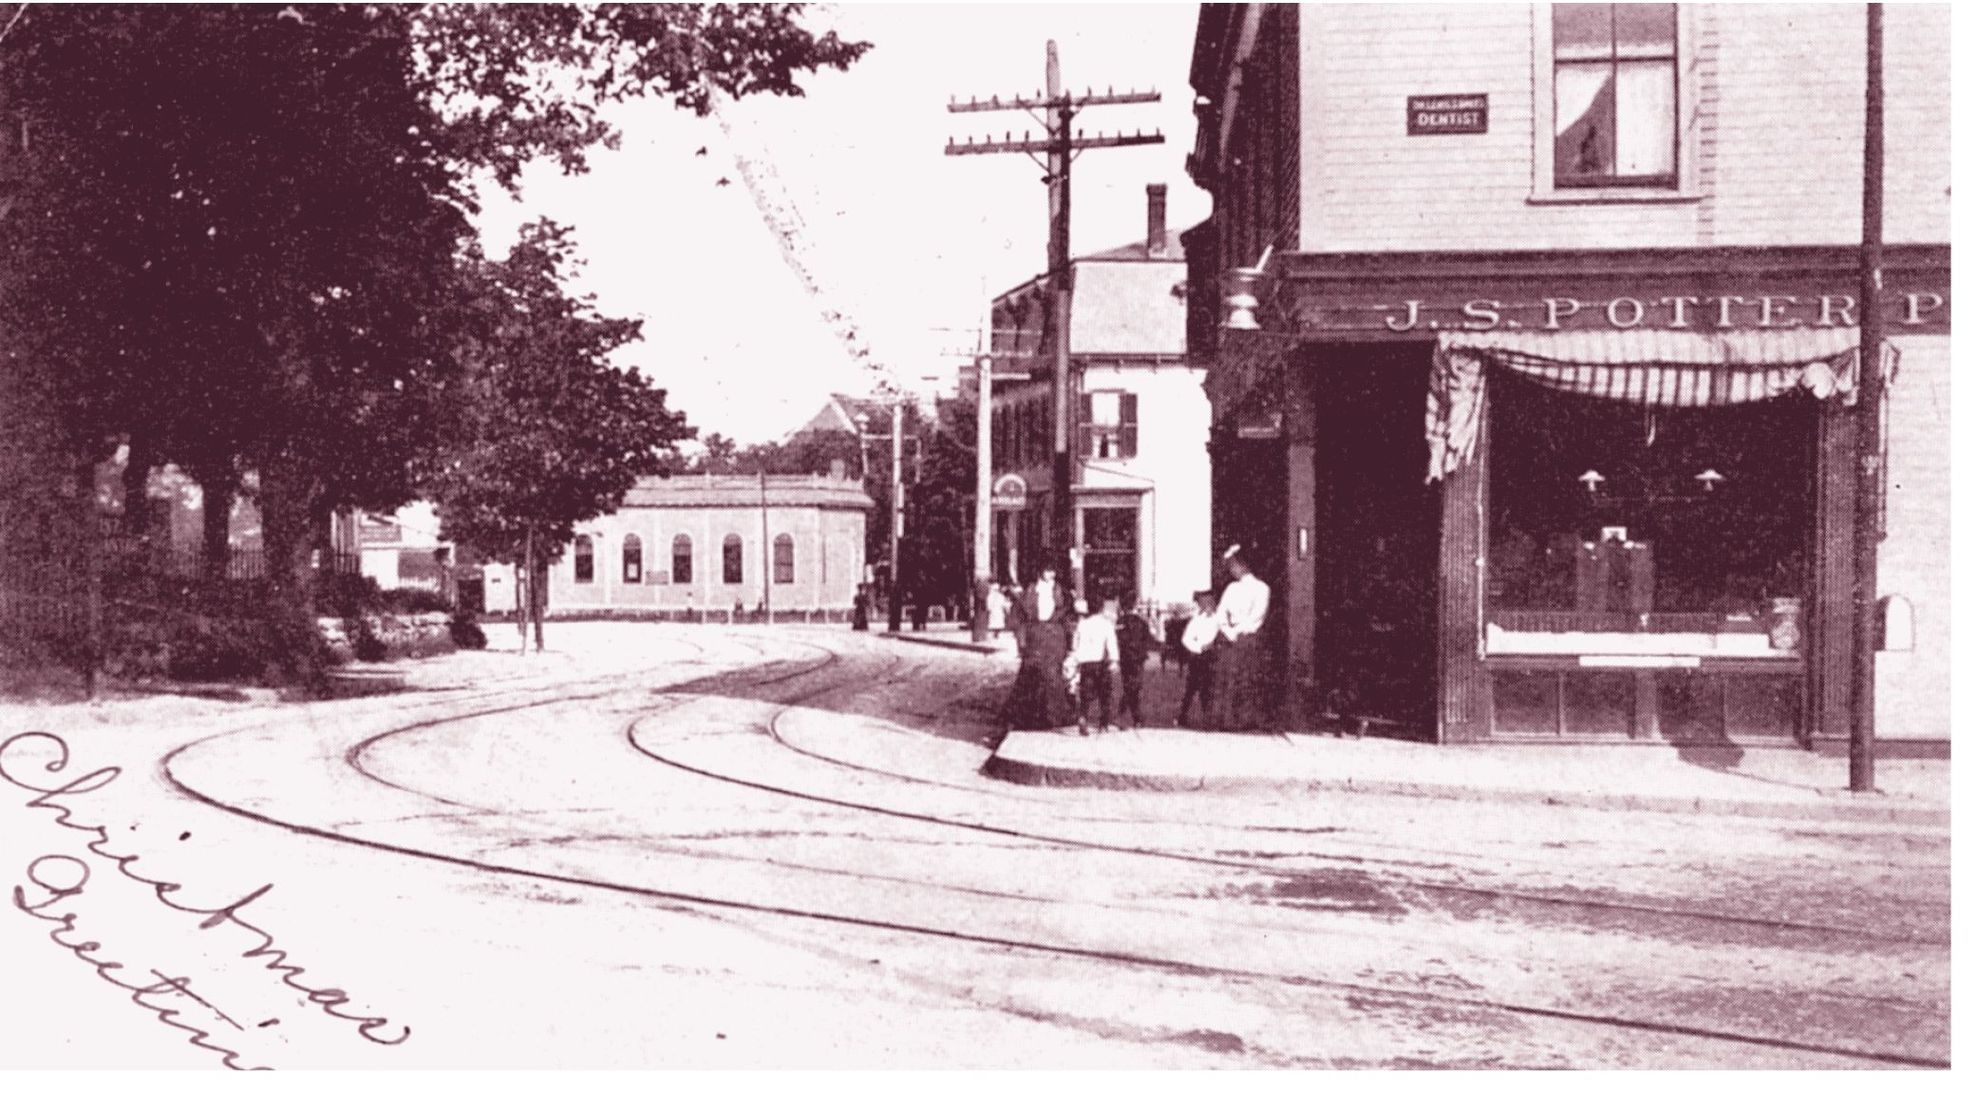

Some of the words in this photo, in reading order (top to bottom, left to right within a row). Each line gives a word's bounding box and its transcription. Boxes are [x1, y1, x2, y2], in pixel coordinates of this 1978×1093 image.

[1417, 112, 1479, 127] DENTIST
[1542, 295, 1859, 330] POTTER
[0, 731, 412, 1045] Christmas
[13, 854, 283, 1071] Greetin
